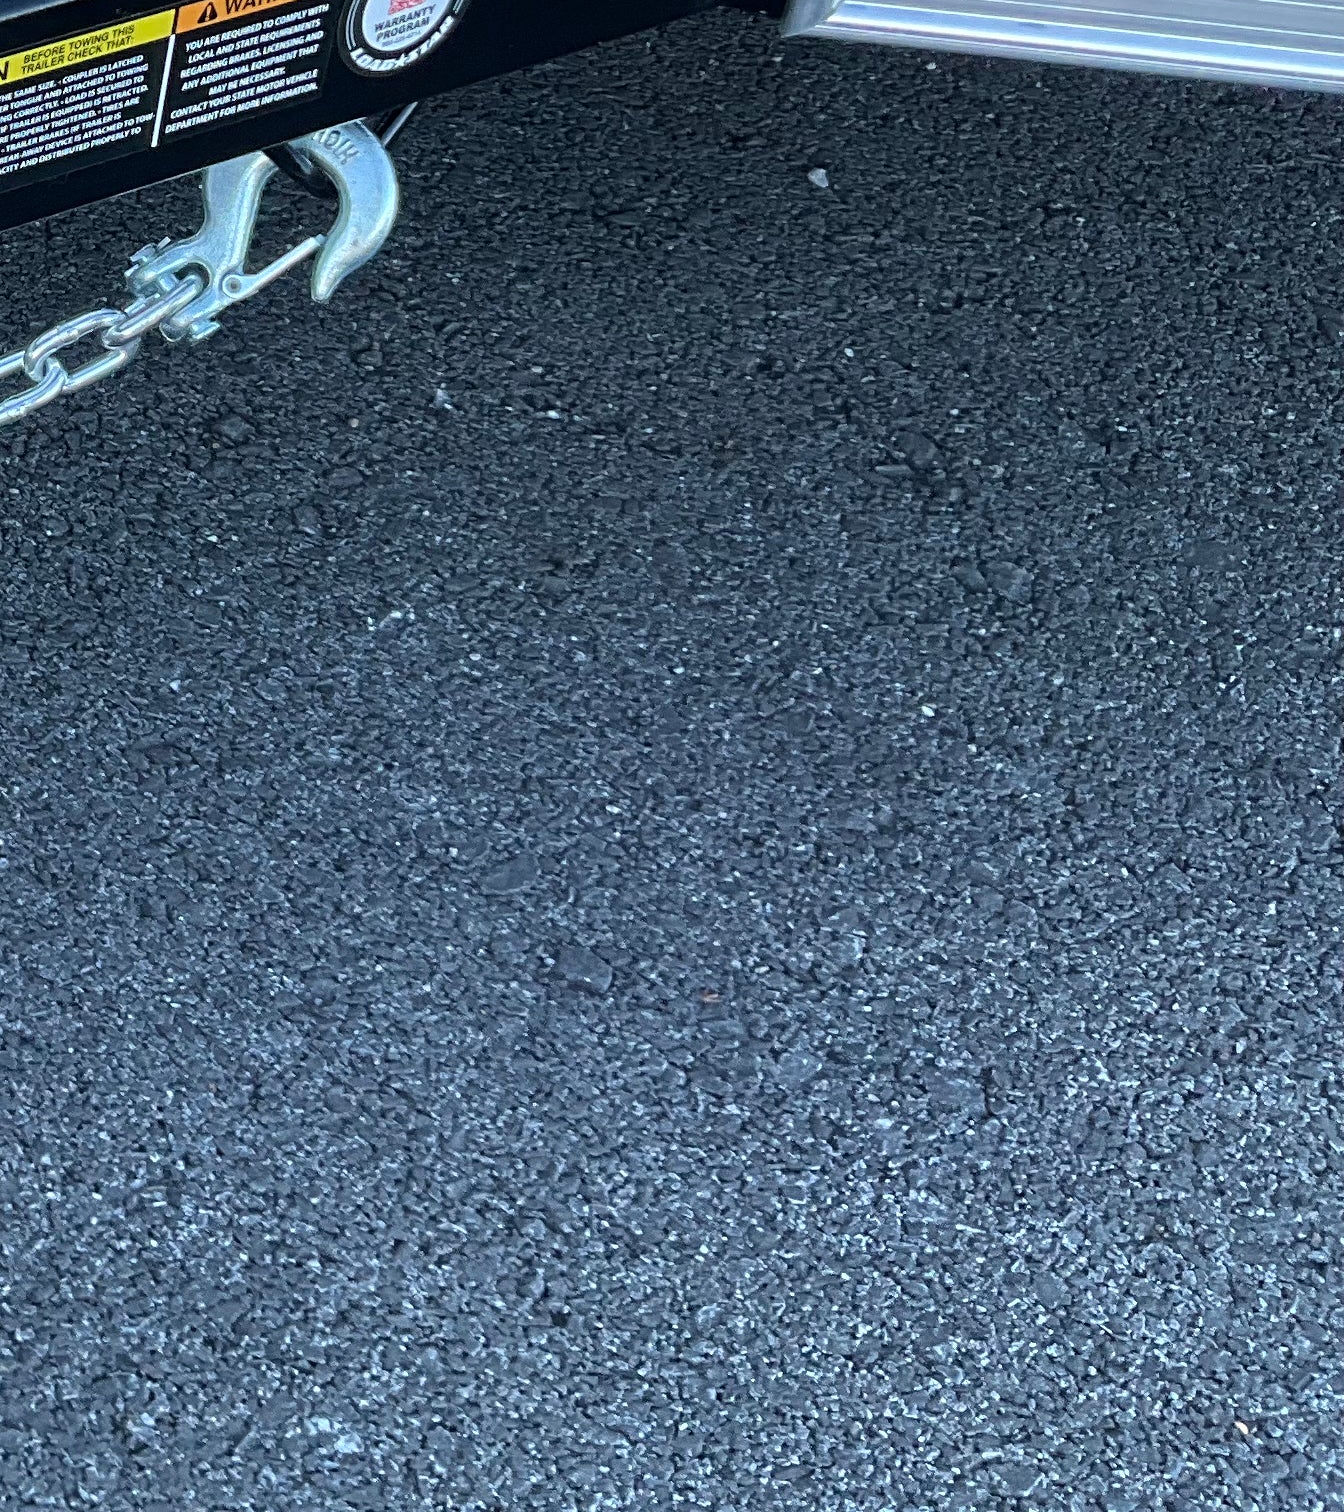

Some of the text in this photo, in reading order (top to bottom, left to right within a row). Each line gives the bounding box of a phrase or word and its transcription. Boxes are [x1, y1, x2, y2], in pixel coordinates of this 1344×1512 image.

[186, 39, 203, 52] YOU
[204, 34, 220, 47] ARE
[221, 23, 262, 41] REQUIRED
[263, 19, 274, 29] TO
[308, 3, 329, 16] WITH
[375, 4, 436, 33] WARRANTY
[376, 17, 430, 42] PROGRAM
[24, 25, 134, 64] BEFORE TOWING THIS
[188, 49, 214, 64] LOCAL
[216, 43, 234, 56] AND
[235, 36, 259, 50] STATE
[304, 30, 324, 42] AND
[21, 35, 133, 74] TRAILER CHECK THAT:
[181, 78, 200, 91] ANY
[200, 64, 249, 85] ADDITIONAL
[298, 44, 319, 57] THAT
[62, 67, 99, 84] COUPLER
[99, 65, 107, 73] IS
[108, 55, 143, 71] LATCHED
[44, 89, 62, 100] AND
[63, 77, 104, 95] ATTACHED
[105, 73, 115, 82] TO
[170, 69, 318, 119] CONTACT YOUR STATE MOTOR VEHICLE
[208, 83, 227, 95] MAY
[165, 110, 219, 133] DEPARTMENT
[219, 105, 236, 117] FOR
[237, 98, 260, 112] MORE
